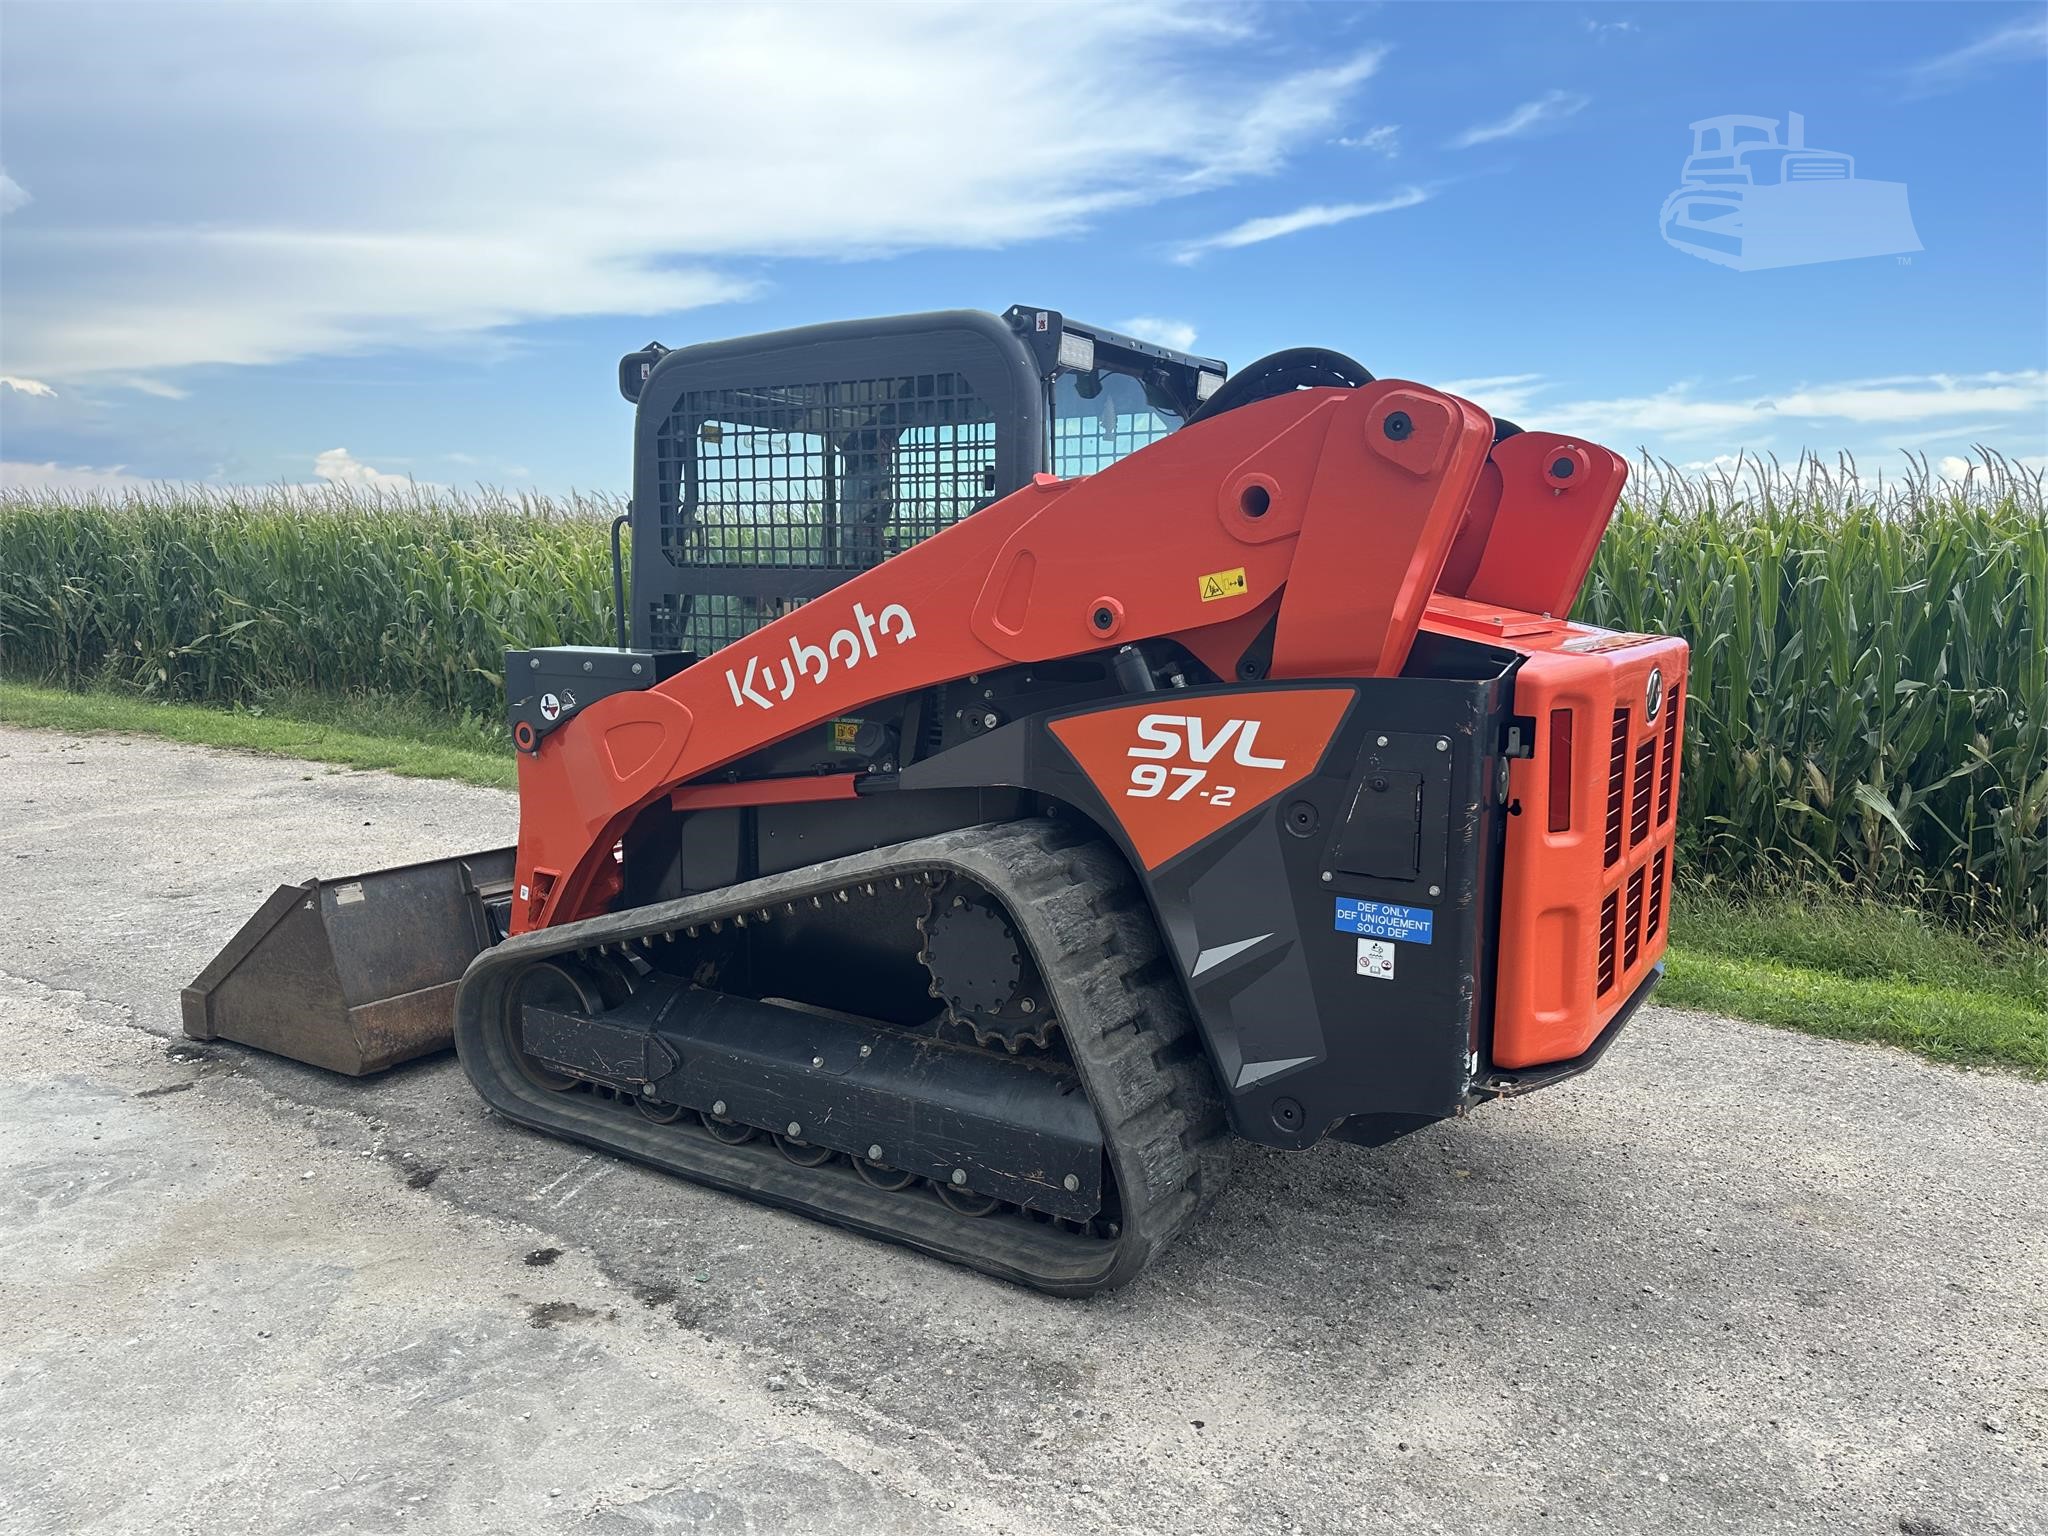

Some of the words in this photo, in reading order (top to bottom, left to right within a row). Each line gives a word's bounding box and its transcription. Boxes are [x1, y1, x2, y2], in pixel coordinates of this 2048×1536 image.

[725, 602, 917, 710] Kubota
[1127, 714, 1287, 770] SVL
[1126, 764, 1236, 807] 97-2
[1337, 909, 1358, 920] DEF
[1360, 913, 1431, 932] UNIQUEMENT
[1357, 902, 1378, 913] DEF
[1381, 906, 1410, 918] ONLY
[1356, 923, 1385, 935] SOLO
[1387, 928, 1409, 939] DEF
